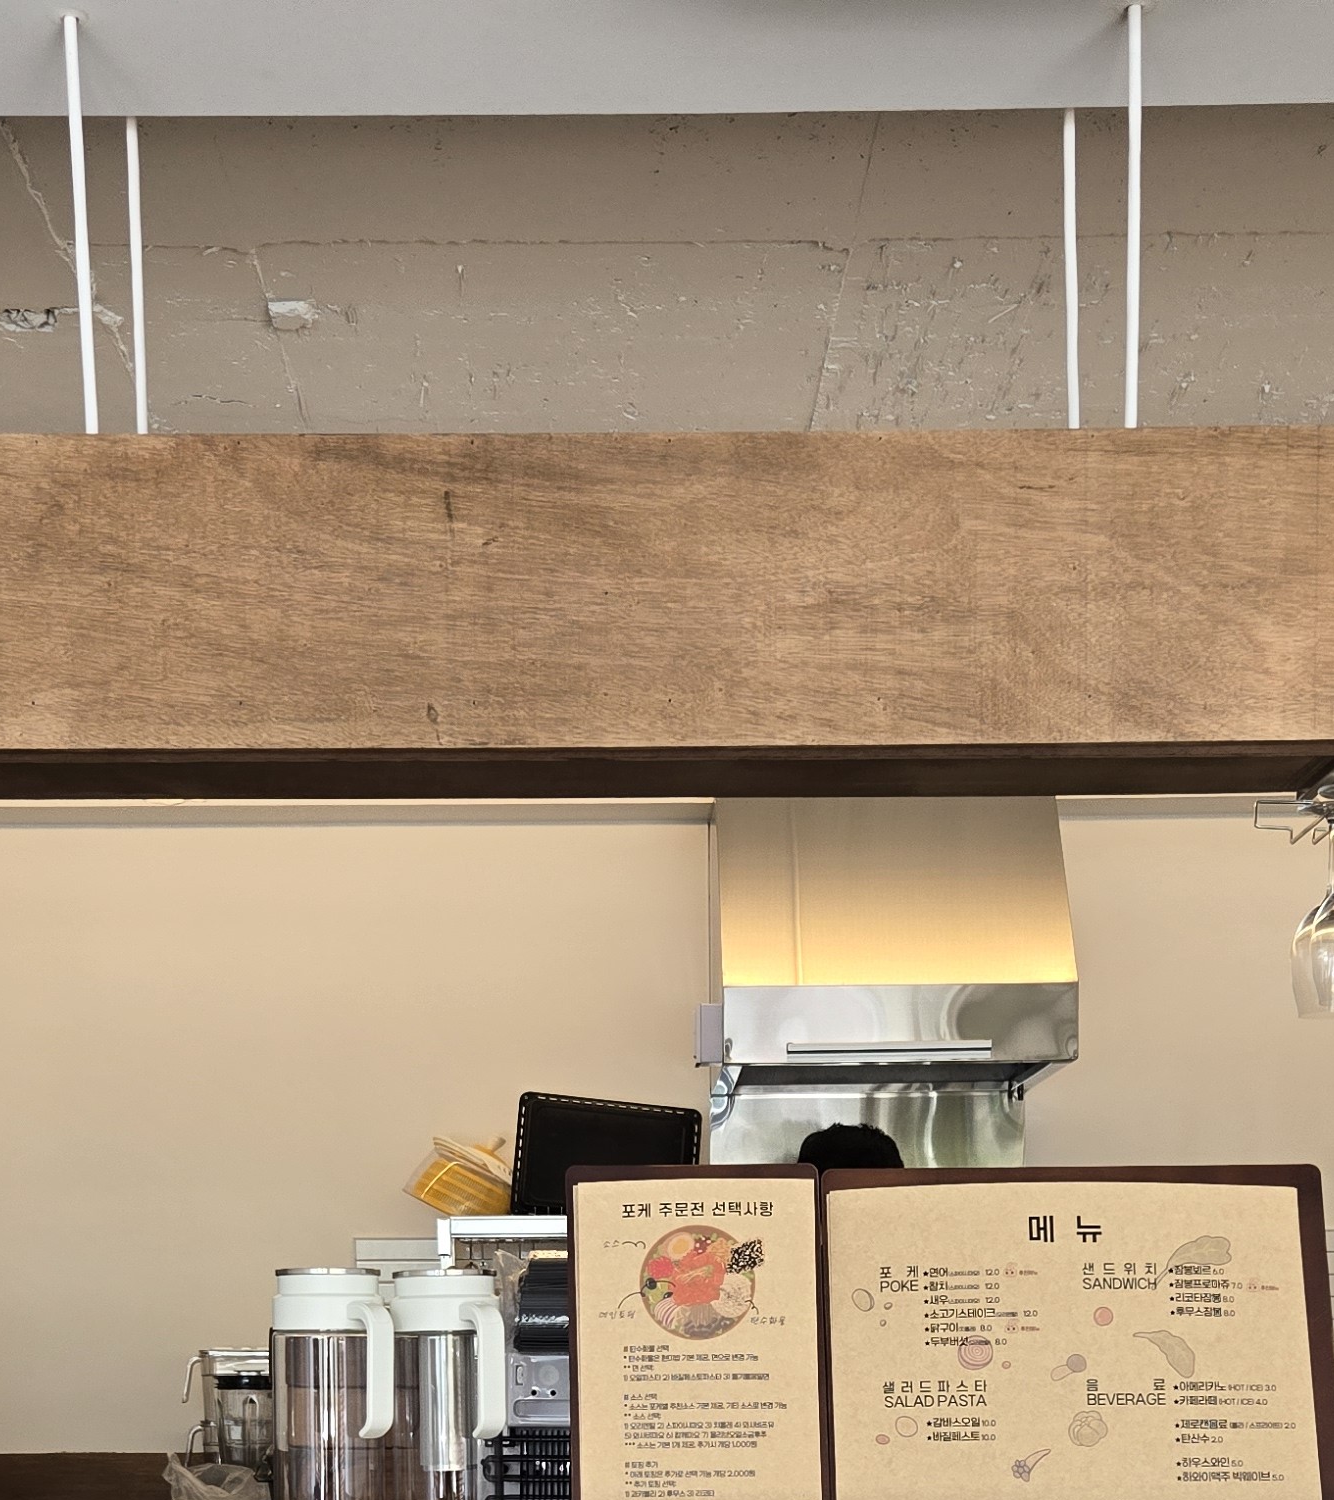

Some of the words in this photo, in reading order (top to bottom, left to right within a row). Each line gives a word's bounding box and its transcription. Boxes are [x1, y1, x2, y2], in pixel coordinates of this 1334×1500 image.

[622, 1203, 651, 1218] 포케
[659, 1202, 705, 1217] 주문전
[712, 1201, 773, 1216] 선택사항
[1029, 1215, 1102, 1242] 메뉴
[880, 1265, 918, 1278] 포케
[1082, 1263, 1157, 1275] 샌드위치
[1174, 1266, 1211, 1275] 잠봉뵈르
[880, 1280, 918, 1292] POKE
[1082, 1278, 1157, 1290] SANDWICH
[1175, 1293, 1221, 1303] 리코타잠봉
[883, 1380, 987, 1394] 샐러드파스타
[1180, 1381, 1226, 1392] 아메리카노
[885, 1395, 935, 1408] SALAD
[938, 1394, 987, 1407] PASTA
[1087, 1393, 1166, 1405] BEVERAGE
[1180, 1396, 1217, 1405] 카페라떼
[933, 1417, 980, 1428] 감바스오일
[933, 1431, 980, 1441] 바질페스토
[1181, 1434, 1210, 1444] 탄산수
[1181, 1457, 1230, 1467] 하우스와인
[1233, 1472, 1271, 1482] 빅웨이브
